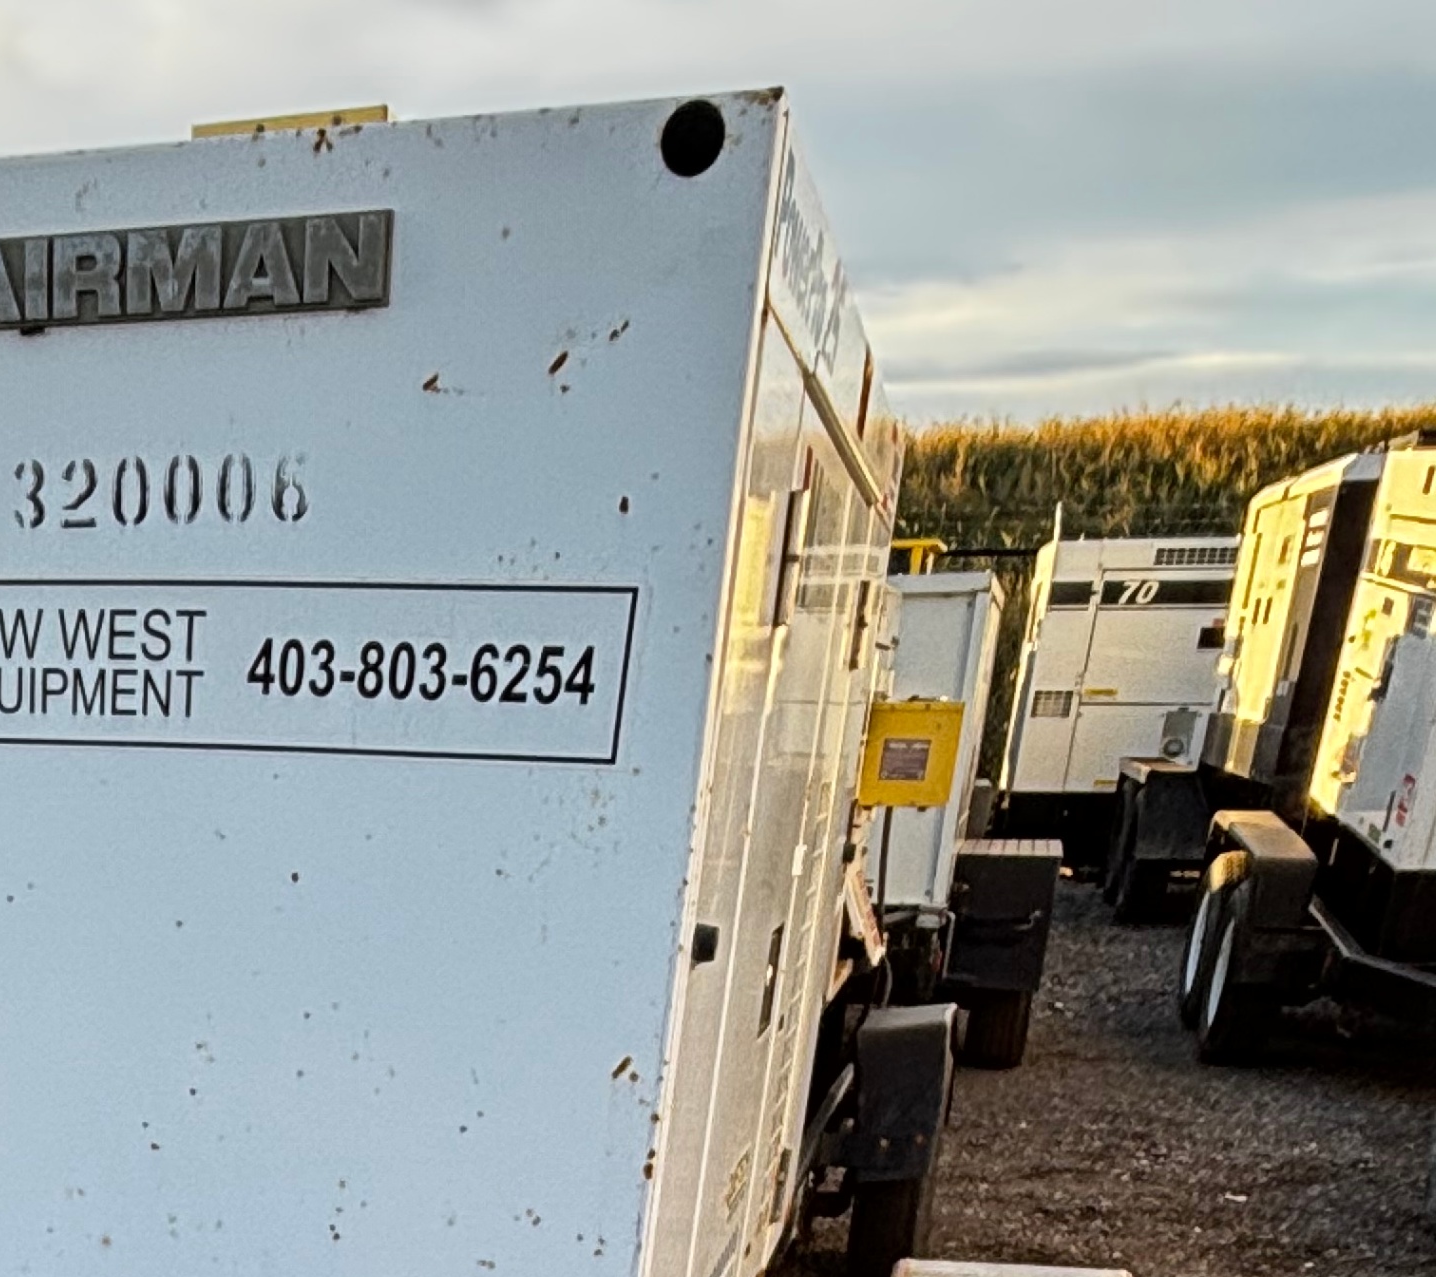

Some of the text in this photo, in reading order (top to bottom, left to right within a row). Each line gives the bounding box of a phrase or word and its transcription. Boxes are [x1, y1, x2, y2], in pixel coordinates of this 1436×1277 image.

[14, 453, 309, 529] 320006
[1117, 580, 1160, 605] 70
[59, 607, 207, 663] WEST
[247, 637, 596, 705] 403-803-6254
